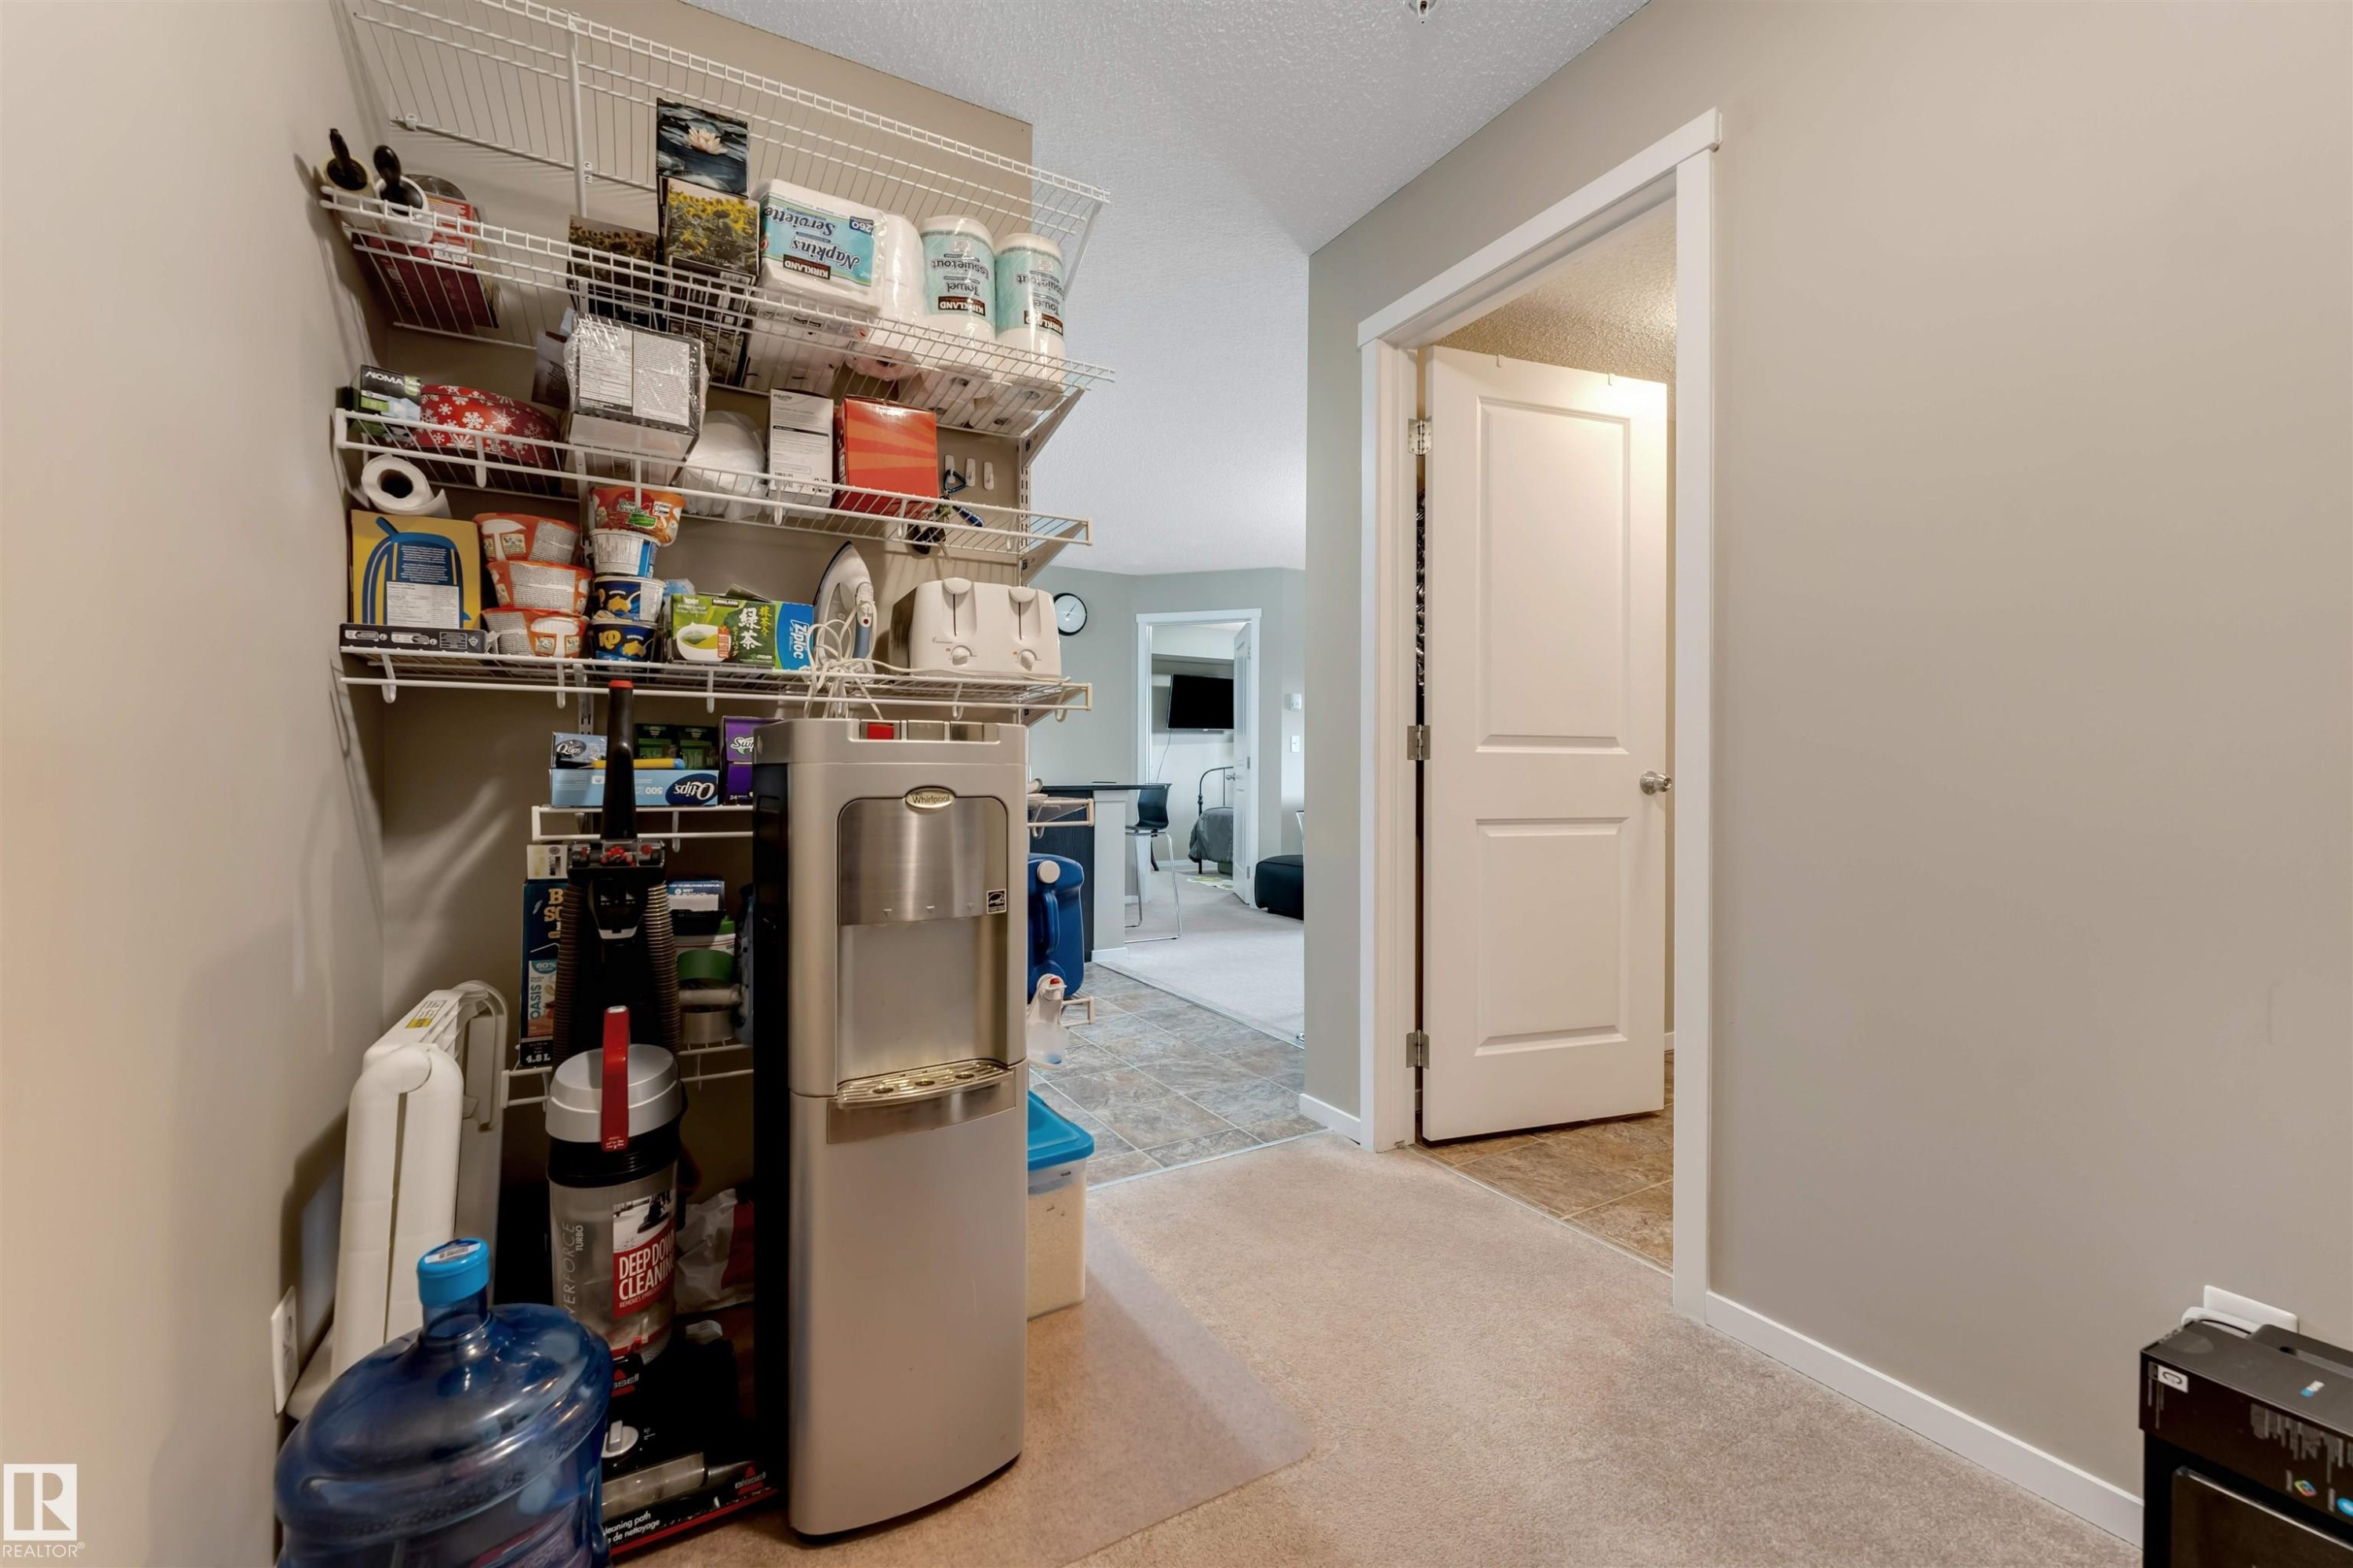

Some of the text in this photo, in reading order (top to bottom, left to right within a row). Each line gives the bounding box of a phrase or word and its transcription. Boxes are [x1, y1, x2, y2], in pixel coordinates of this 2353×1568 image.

[764, 206, 835, 237] Serviette
[851, 220, 873, 233] 260
[791, 238, 860, 271] Napkins
[784, 260, 829, 278] KIRKLAND
[946, 282, 980, 297] Towel
[939, 300, 984, 315] KIRKLAND
[1025, 315, 1063, 333] KIRKLD
[365, 371, 404, 385] NOMA
[738, 607, 762, 650] 緑茶
[791, 624, 809, 660] Ziploc
[646, 787, 664, 795] 500
[674, 781, 715, 800] Q-tips
[912, 795, 951, 805] Whirlpool
[529, 984, 542, 1020] OASIS
[526, 1053, 542, 1064] 4.8
[619, 1247, 650, 1280] DEEP
[605, 1510, 651, 1534] leaning path
[612, 1531, 624, 1543] de
[624, 1519, 660, 1538] nettoyage
